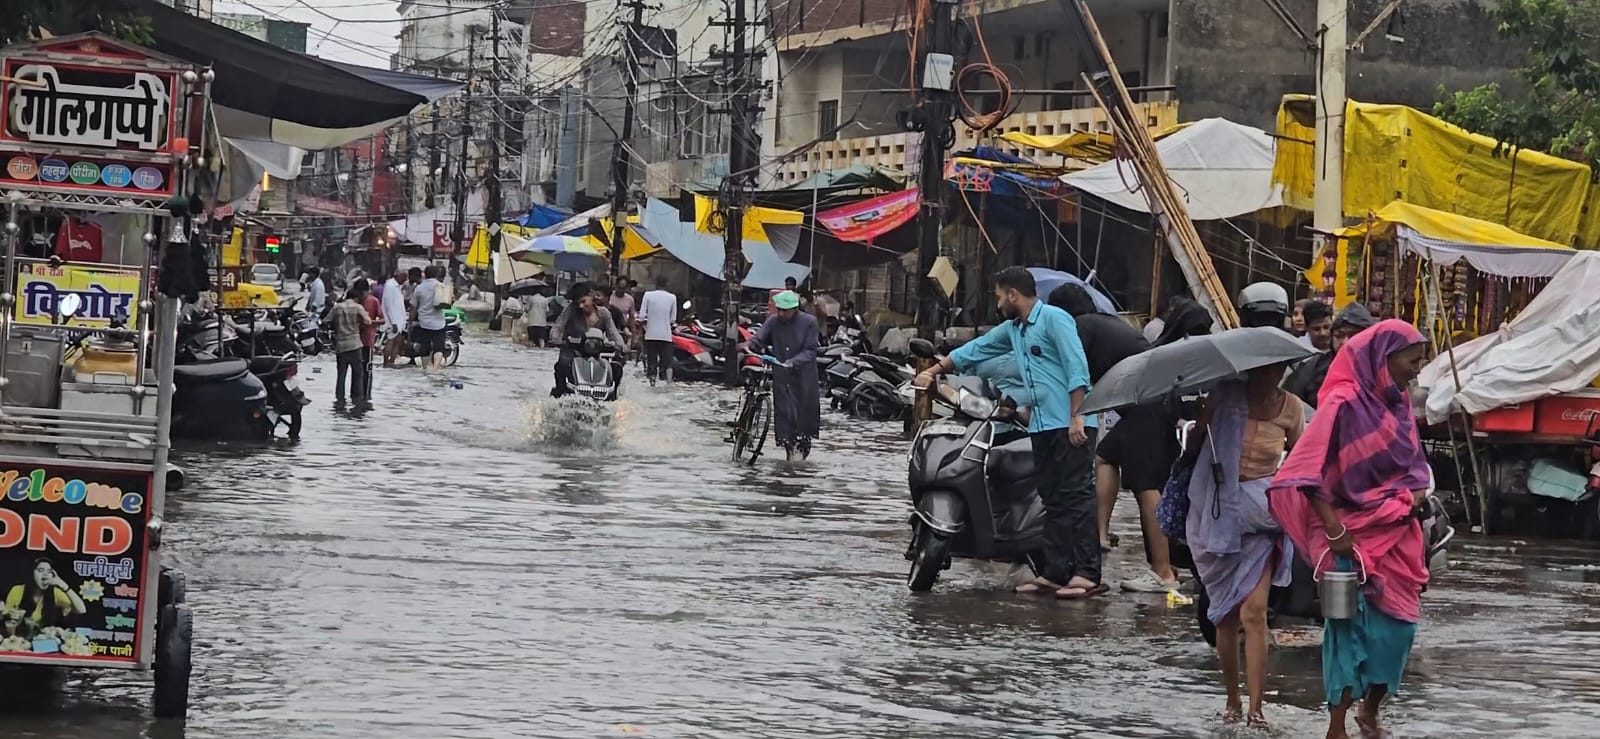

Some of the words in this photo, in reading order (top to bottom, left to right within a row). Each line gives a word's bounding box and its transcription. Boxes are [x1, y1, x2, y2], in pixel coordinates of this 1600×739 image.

[17, 68, 161, 147] गोलगप्पे
[74, 556, 134, 584] पानीपुरी
[110, 644, 133, 656] पानी
